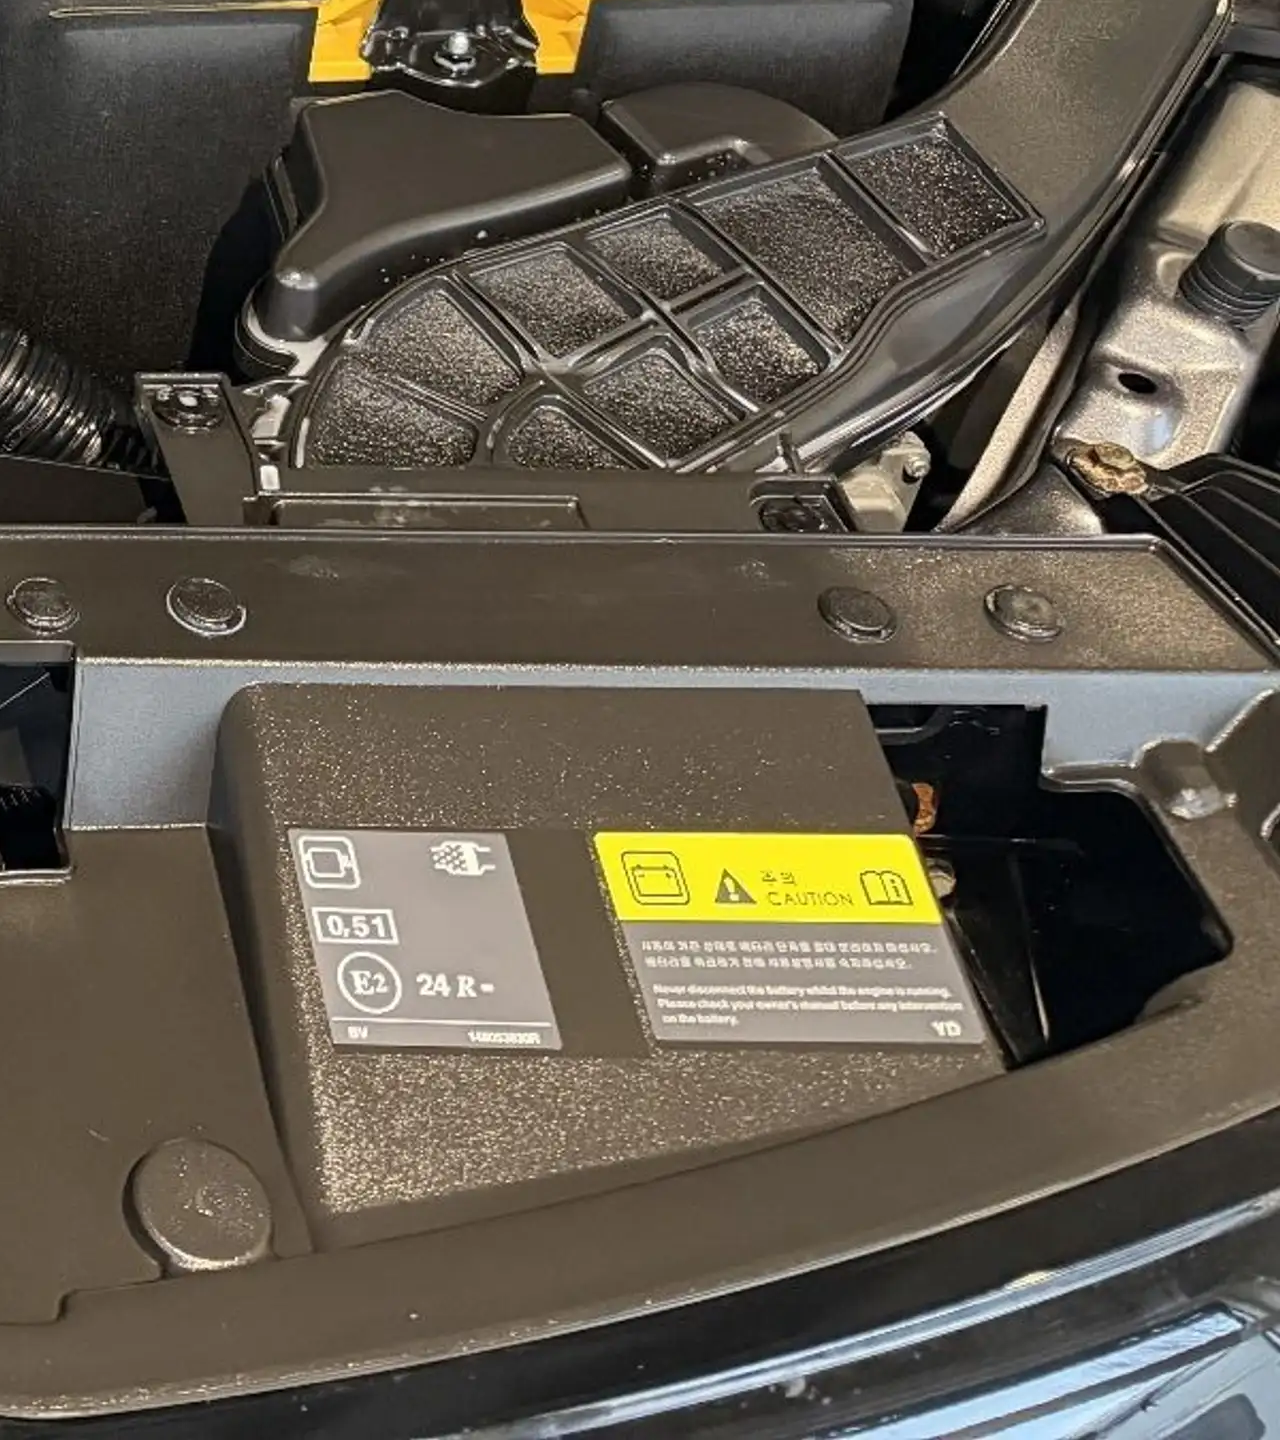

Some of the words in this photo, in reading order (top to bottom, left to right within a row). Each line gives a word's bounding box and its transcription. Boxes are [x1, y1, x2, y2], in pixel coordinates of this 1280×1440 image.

[767, 891, 854, 906] CAUTION
[416, 973, 452, 997] 24
[653, 984, 686, 995] Never
[687, 984, 746, 995] disconnect
[746, 985, 765, 995] the
[765, 985, 805, 997] battery
[838, 986, 857, 996] the
[858, 987, 895, 998] engine
[906, 987, 952, 999] running.
[657, 998, 697, 1009] Please
[697, 999, 730, 1009] check
[730, 1001, 754, 1011] your
[799, 1000, 839, 1011] manual
[839, 1000, 876, 1011] before
[876, 1001, 897, 1012] any
[662, 1014, 677, 1024] on
[678, 1013, 696, 1024] the
[696, 1014, 739, 1028] battery.
